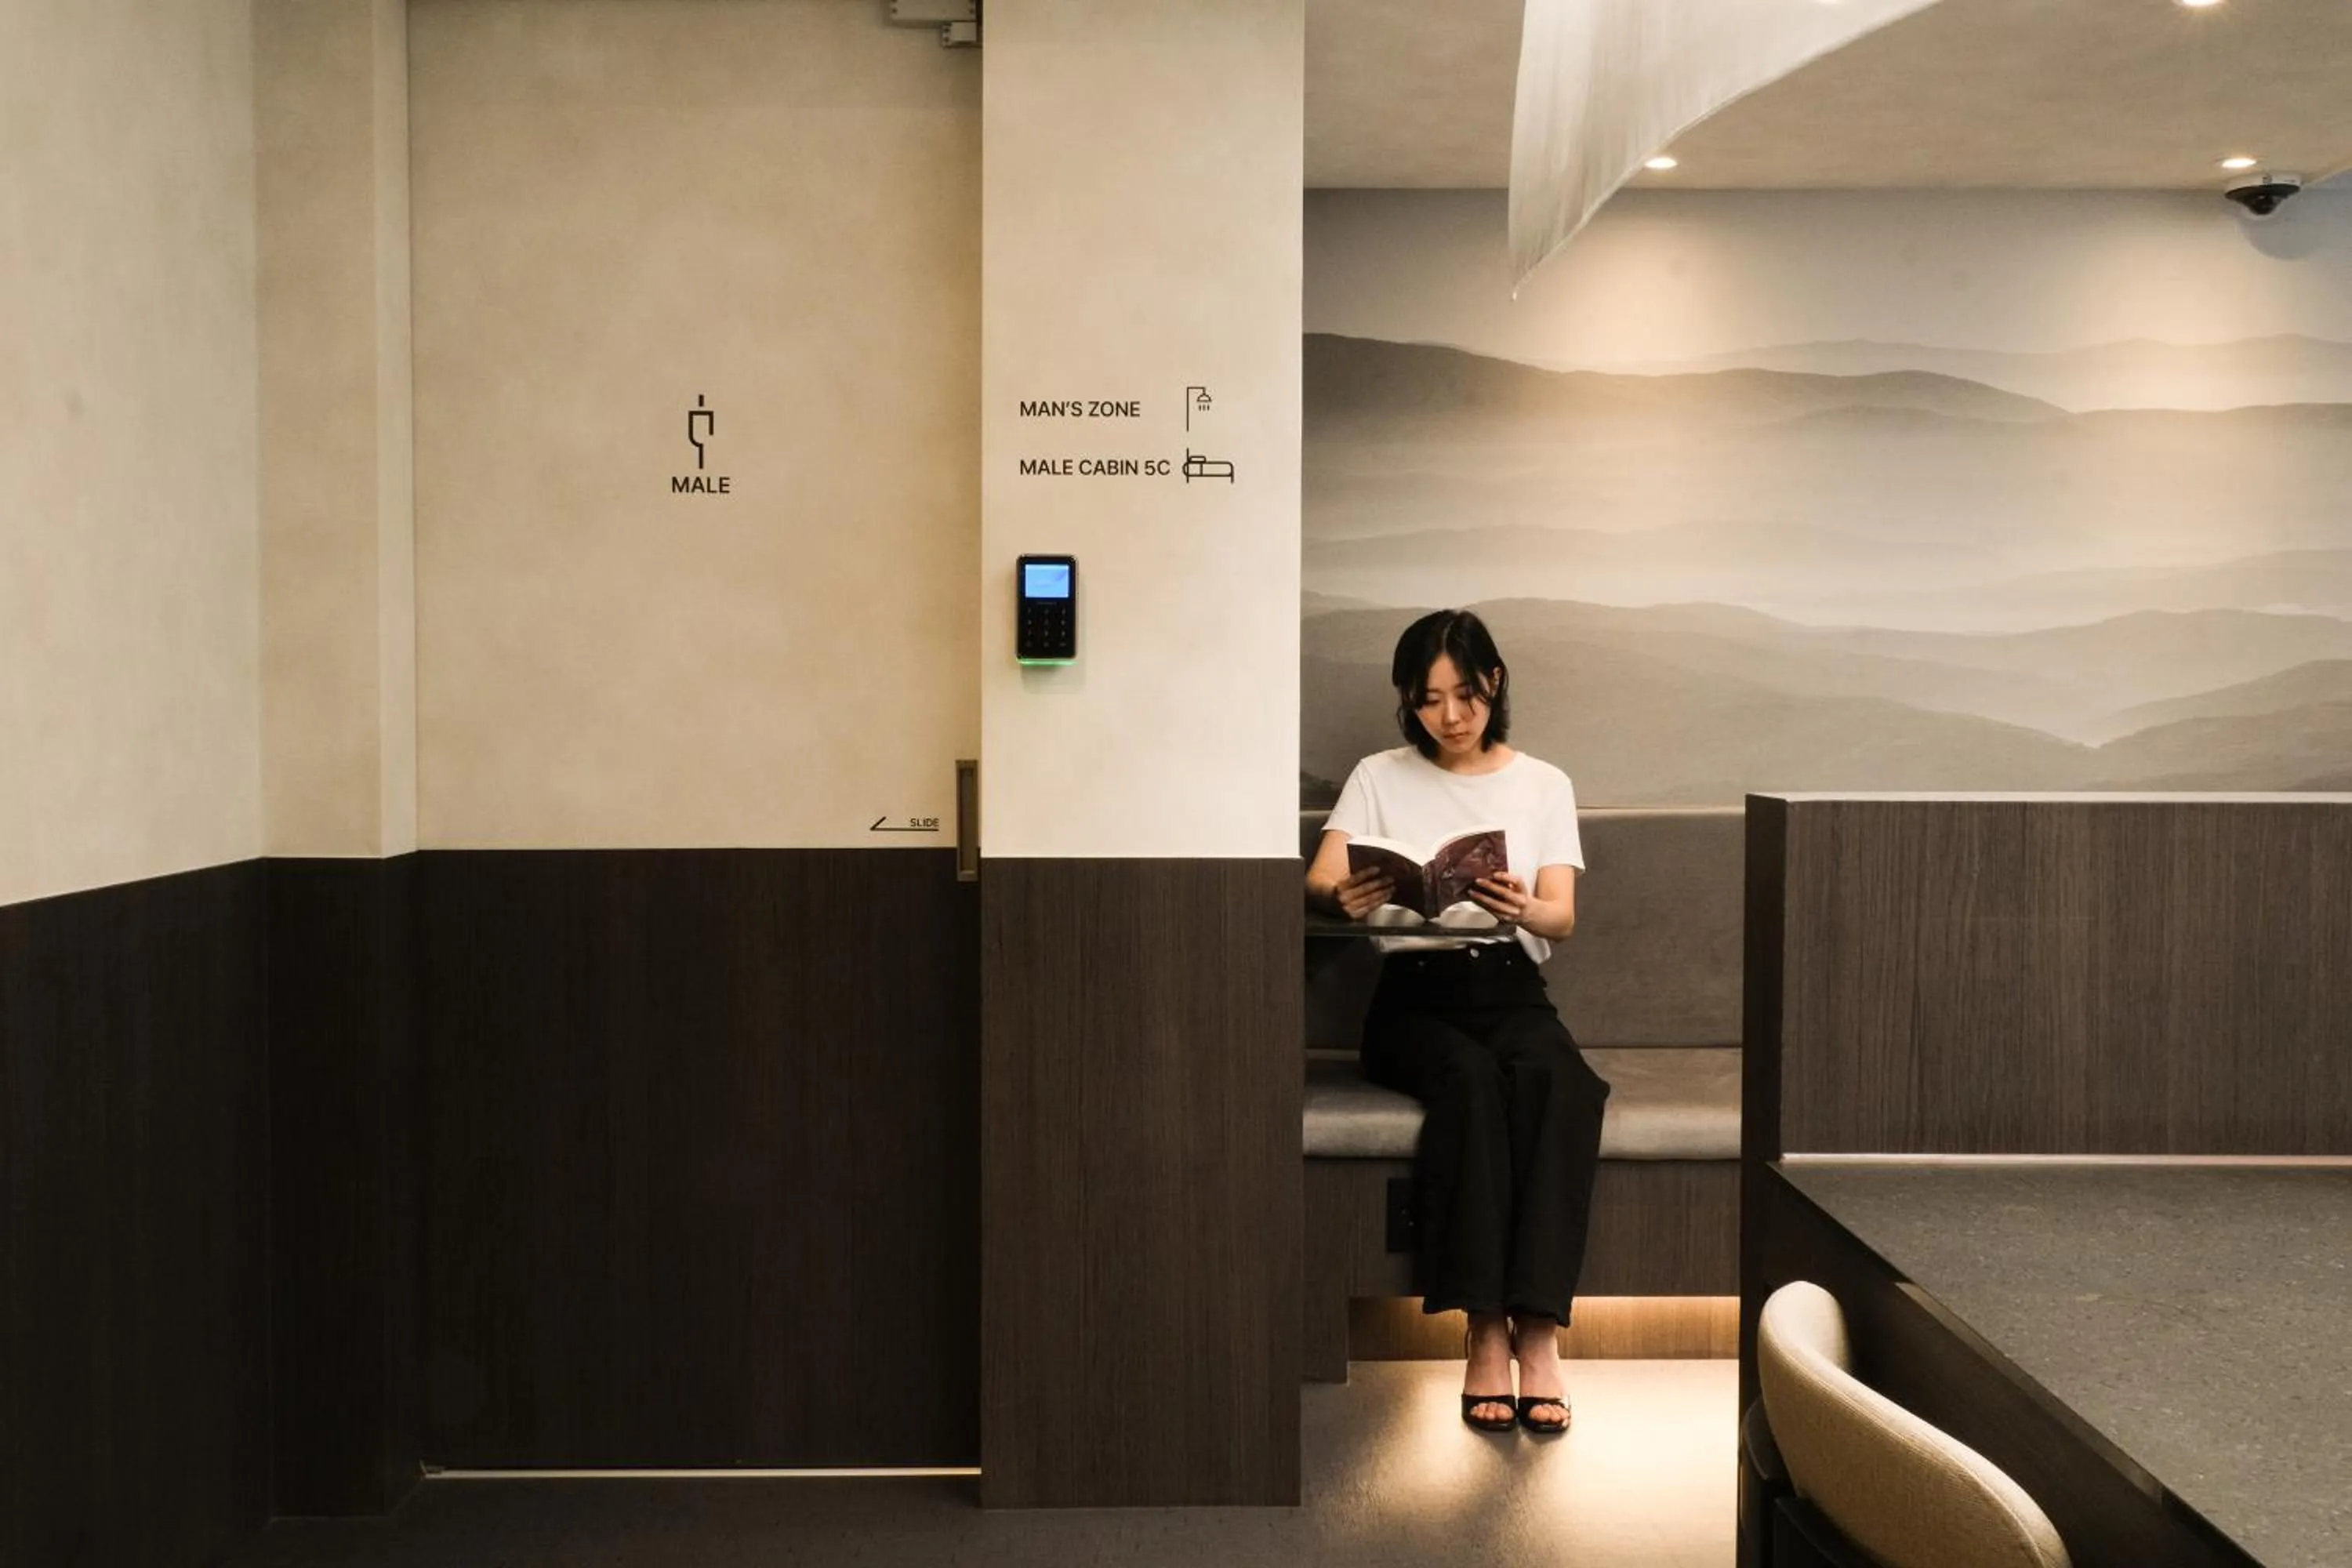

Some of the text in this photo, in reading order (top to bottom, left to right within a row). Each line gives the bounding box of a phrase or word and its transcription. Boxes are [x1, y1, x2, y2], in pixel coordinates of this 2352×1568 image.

[1019, 401, 1141, 417] MAN'S ZONE
[1019, 459, 1171, 476] MALE CABIN 5C
[672, 477, 730, 493] MALE
[910, 818, 939, 827] SLIDE
